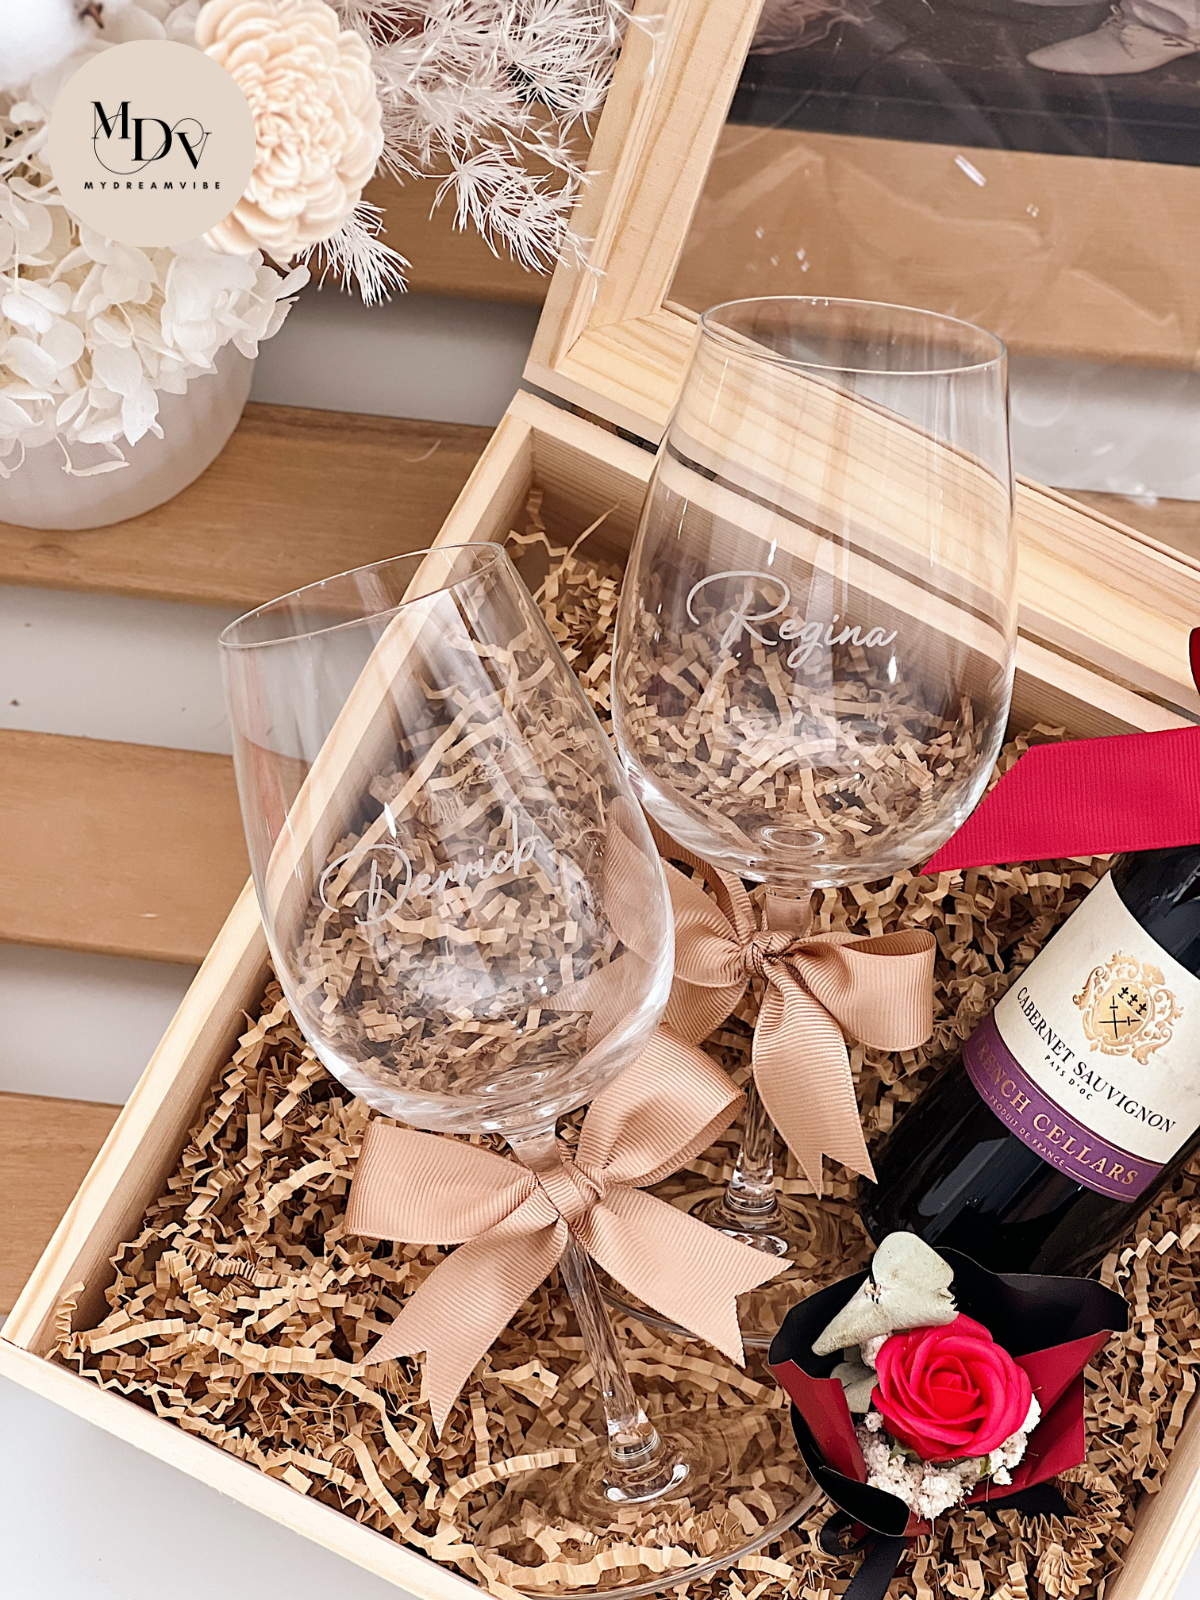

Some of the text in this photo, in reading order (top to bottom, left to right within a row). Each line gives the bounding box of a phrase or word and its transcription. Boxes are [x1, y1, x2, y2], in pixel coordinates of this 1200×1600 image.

[686, 570, 898, 668] Regina
[319, 812, 537, 926] Derrick
[1017, 987, 1177, 1133] CABERNET SAUVIGNON
[1044, 1055, 1094, 1101] PAYS D'OC
[989, 1095, 1065, 1167] PRODUIT DE FRANCE
[1033, 1113, 1139, 1185] CELLARS
